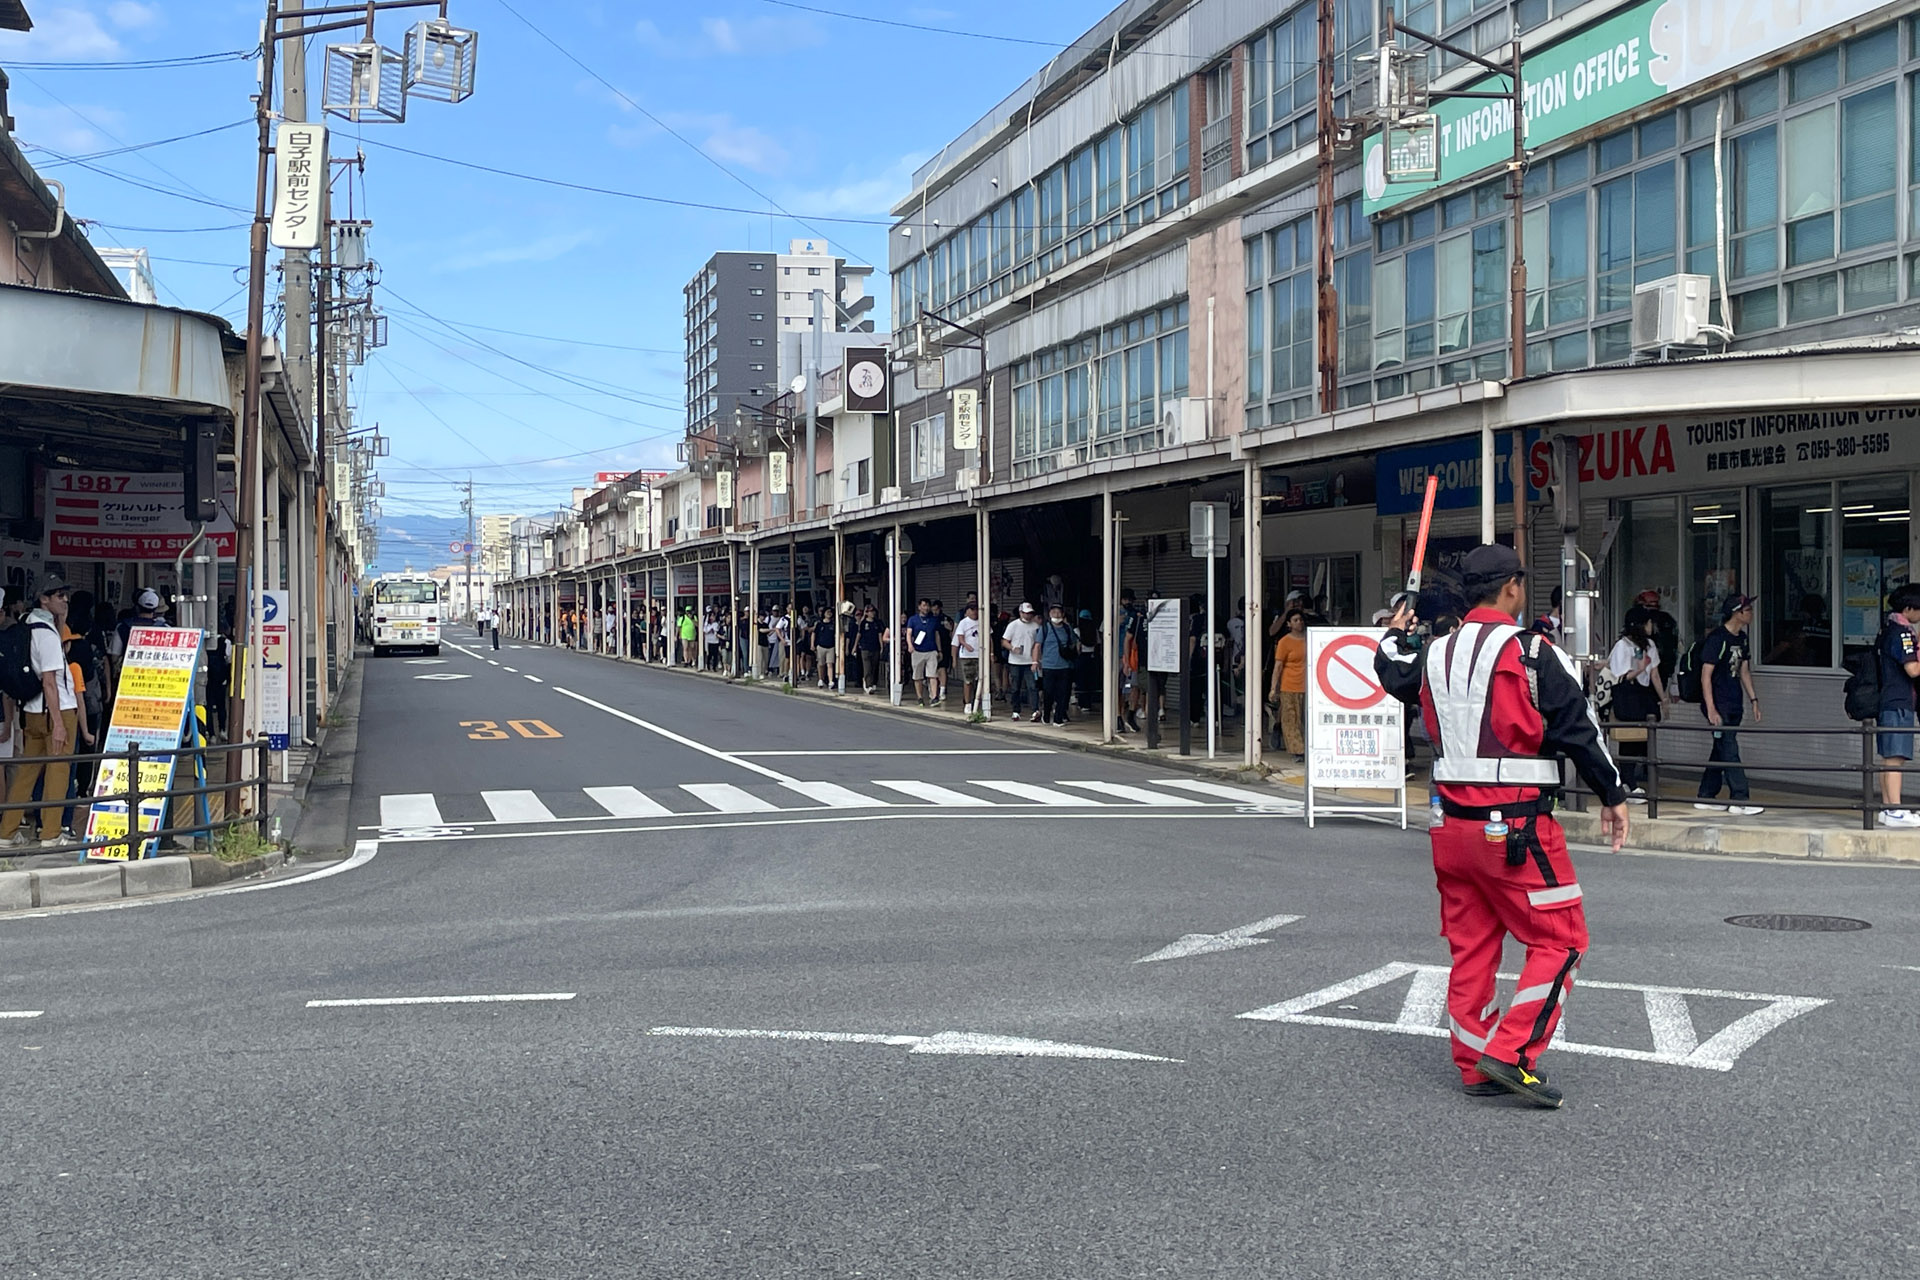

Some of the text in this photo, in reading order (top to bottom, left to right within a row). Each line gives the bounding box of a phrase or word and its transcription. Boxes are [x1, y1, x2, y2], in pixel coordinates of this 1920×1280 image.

[1456, 70, 1567, 152] INFORMTION
[1573, 37, 1640, 101] OFFICE
[284, 131, 312, 240] 白子駅前センター
[1686, 418, 1747, 446] TOURIST
[1751, 411, 1860, 438] INFORMATION
[1530, 423, 1676, 490] SZUKA
[1707, 432, 1890, 472] 鈴鹿市観光協会 059-380-5595
[60, 473, 131, 493] 1987
[140, 481, 177, 489] WINNER
[57, 535, 136, 549] WELCOME
[142, 537, 162, 549] TO
[127, 649, 195, 662] 運賃は後払いです
[459, 719, 563, 740] 30
[1323, 713, 1396, 725] 鈴鹿警察署長
